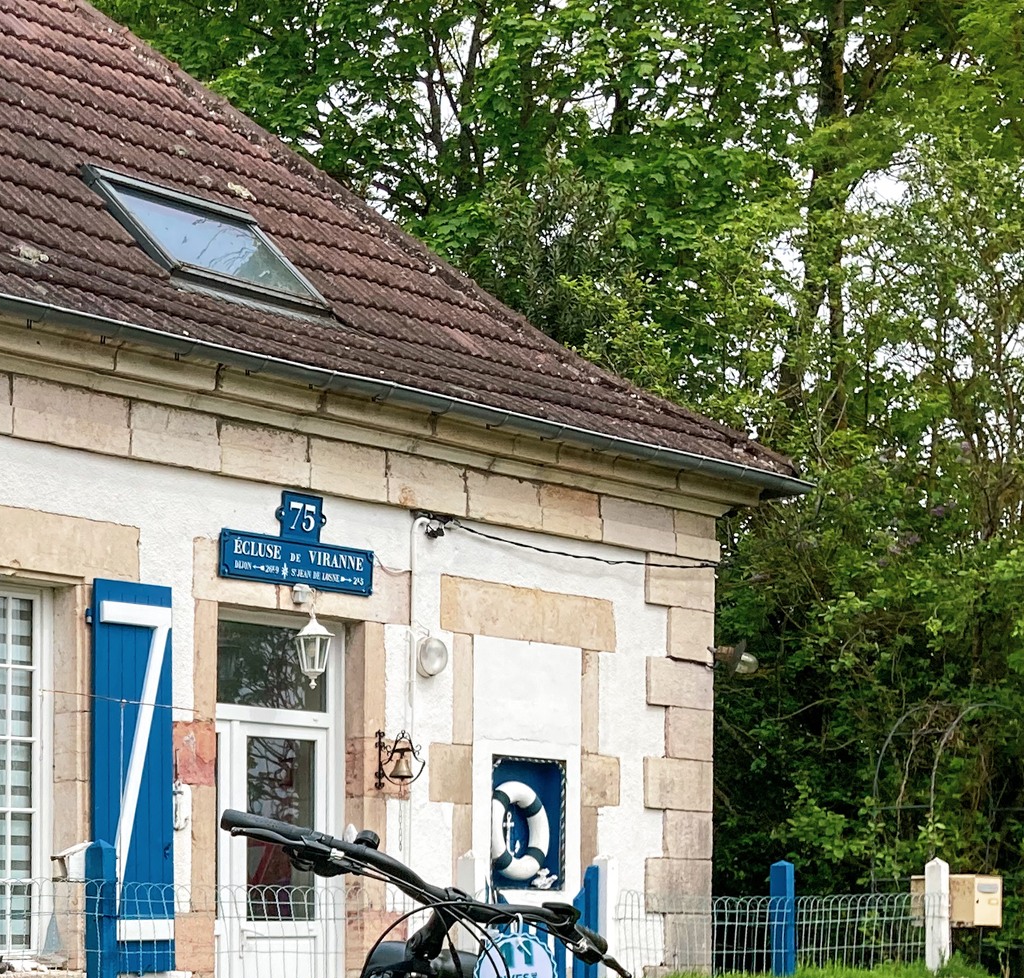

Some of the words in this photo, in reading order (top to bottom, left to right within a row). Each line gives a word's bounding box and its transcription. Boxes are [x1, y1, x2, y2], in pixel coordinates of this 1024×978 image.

[289, 501, 316, 532] 75
[233, 536, 282, 560] ÉCLUSE
[290, 553, 301, 563] DE
[308, 550, 364, 572] VIRANNE
[234, 559, 252, 570] DIJON
[297, 568, 312, 580] JEAN
[313, 571, 321, 581] DE
[322, 572, 340, 583] LOSNE
[498, 940, 534, 968] 11
